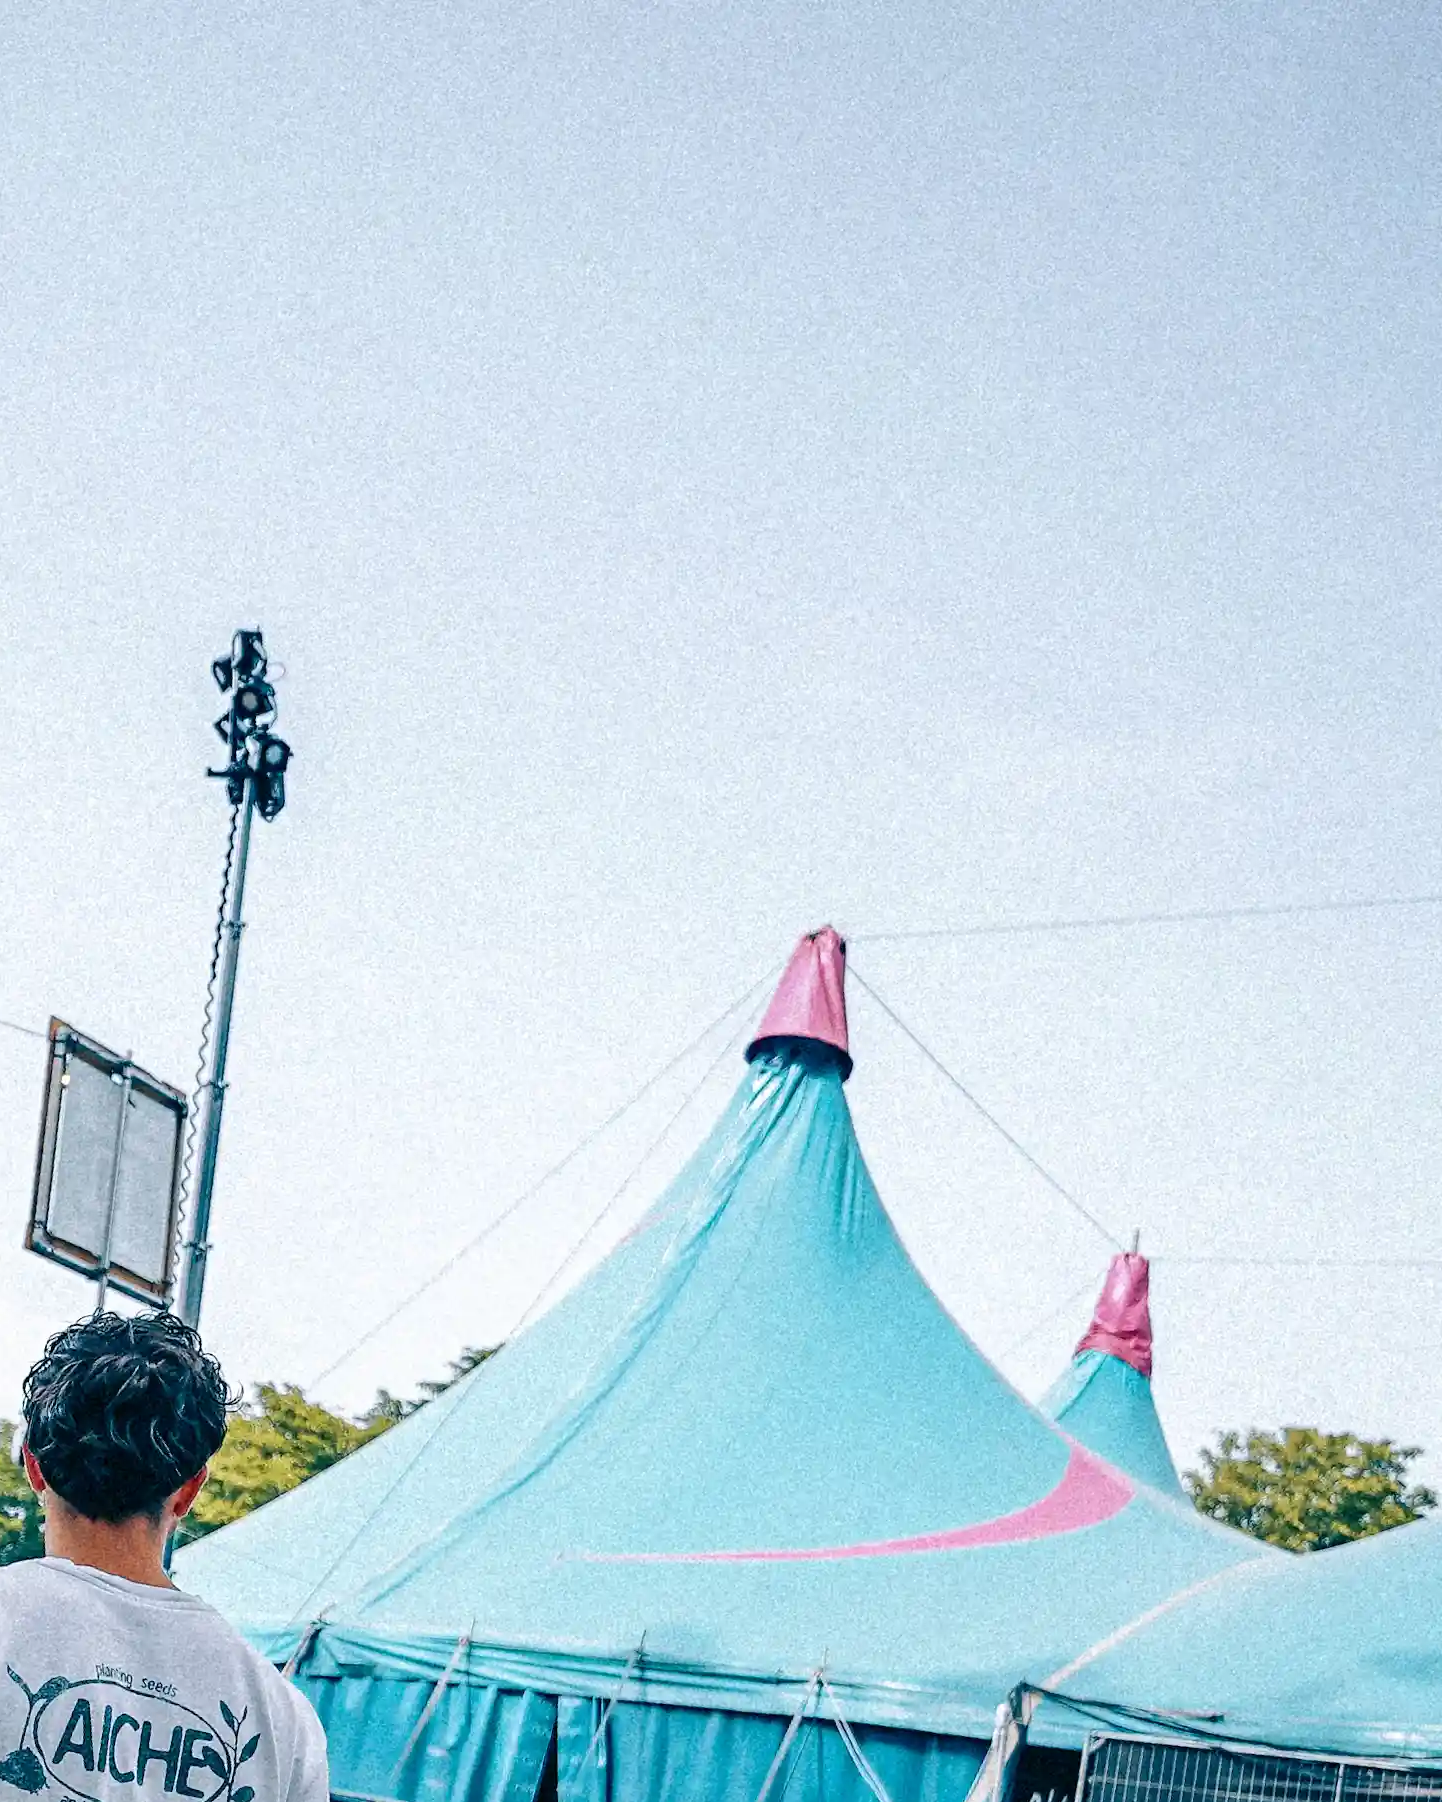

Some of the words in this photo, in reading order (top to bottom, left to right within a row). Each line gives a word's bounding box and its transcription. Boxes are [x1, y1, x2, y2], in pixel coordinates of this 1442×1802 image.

[95, 1663, 133, 1690] planting
[141, 1678, 179, 1698] seeds
[52, 1698, 214, 1799] AICHE
